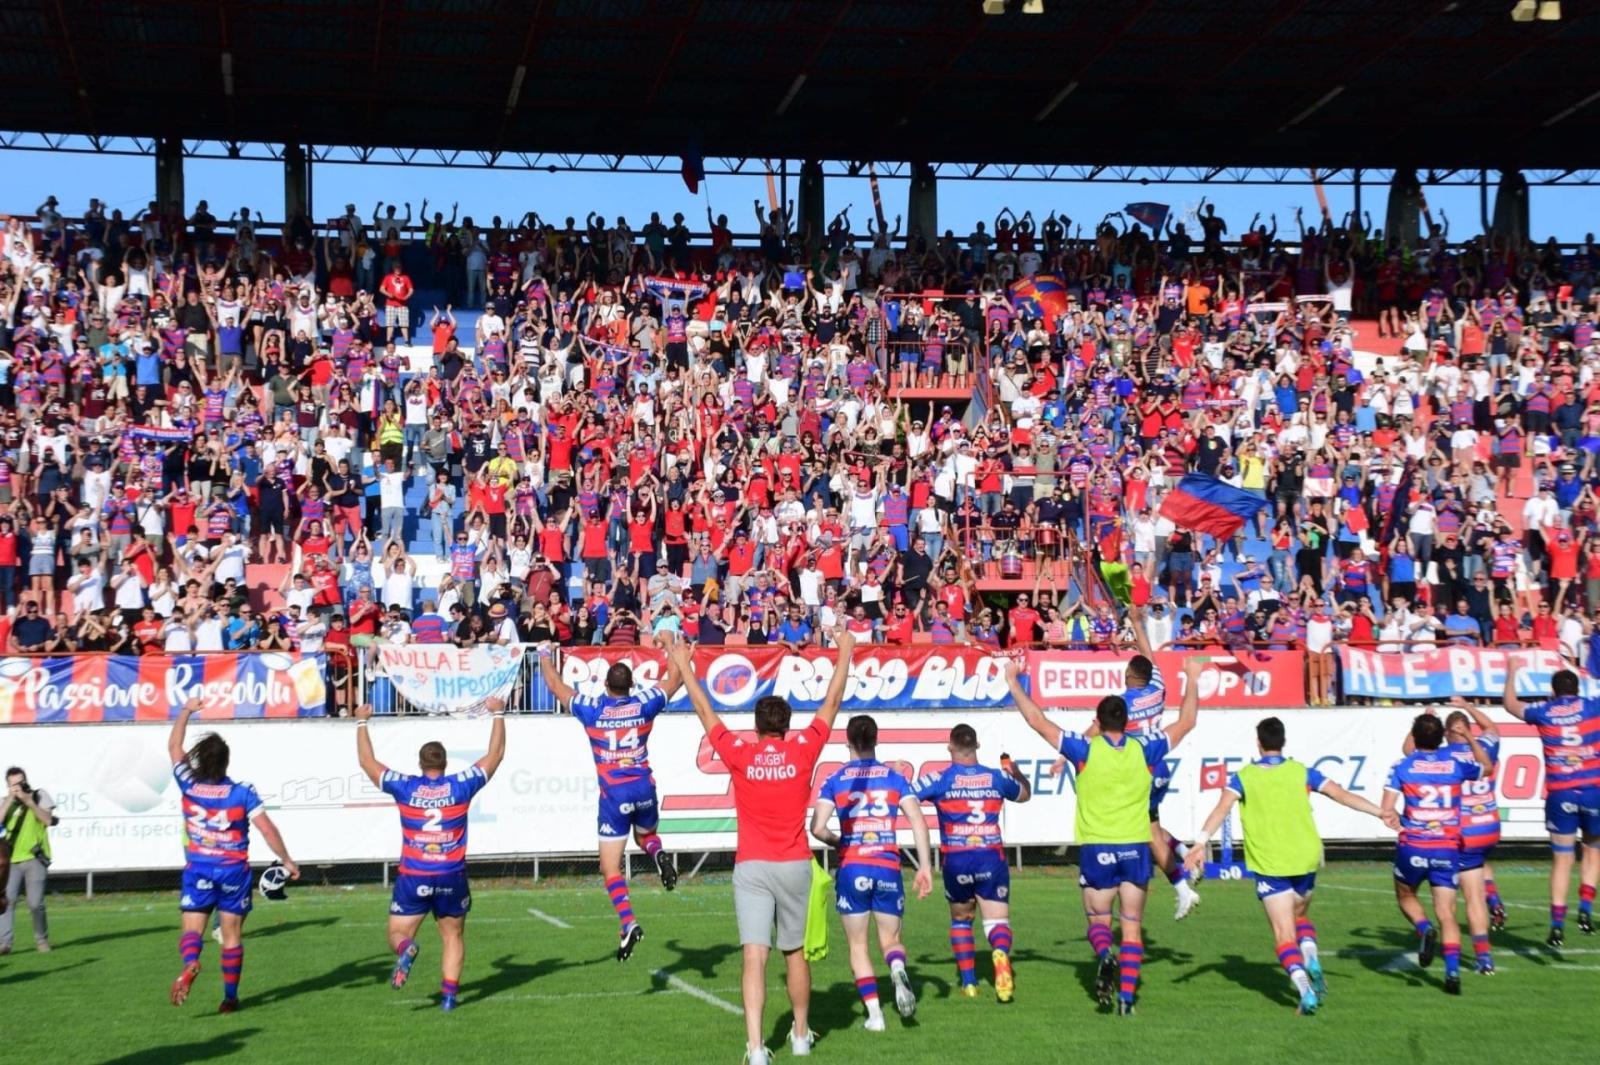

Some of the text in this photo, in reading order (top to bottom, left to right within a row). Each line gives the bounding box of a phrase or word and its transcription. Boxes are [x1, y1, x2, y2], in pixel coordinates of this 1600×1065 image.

[383, 650, 452, 671] NULLA
[14, 663, 291, 710] Passione Rossoblu
[1044, 669, 1128, 690] PERON
[596, 718, 645, 728] BACCHETTI
[604, 727, 641, 751] 14
[1561, 725, 1584, 747] 5
[754, 752, 786, 766] RUGBY
[746, 764, 797, 781] ROVIGO
[54, 792, 90, 812] RIS
[409, 797, 456, 809] LECCIOLI
[848, 790, 891, 818] 23
[945, 789, 1001, 799] SWANEPOEL
[1418, 784, 1453, 809] 21
[188, 804, 232, 831] 24
[421, 808, 443, 832] 2
[966, 800, 987, 824] 3
